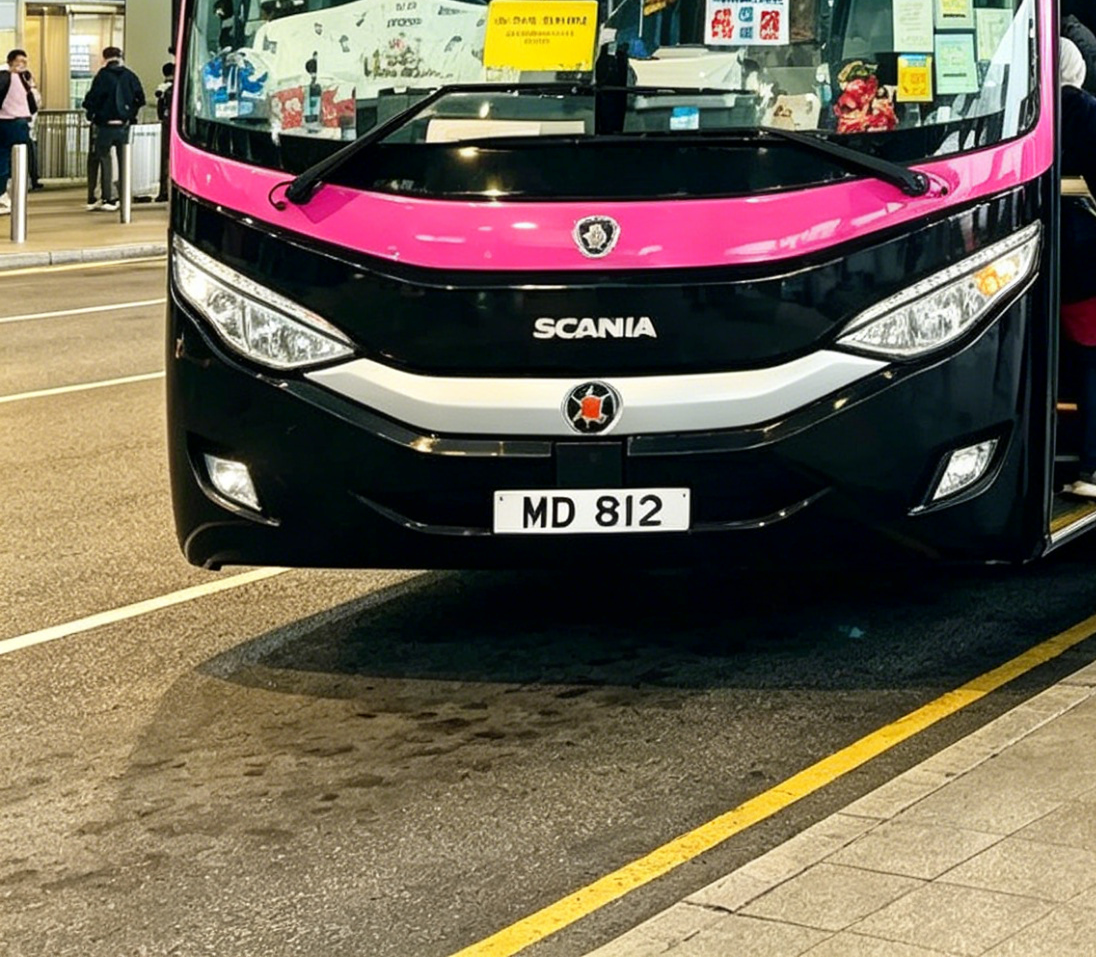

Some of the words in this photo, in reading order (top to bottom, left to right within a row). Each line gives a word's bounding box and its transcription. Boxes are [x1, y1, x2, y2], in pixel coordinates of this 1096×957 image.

[532, 316, 657, 339] SCANIA
[523, 496, 576, 529] MD
[595, 494, 663, 527] 812
